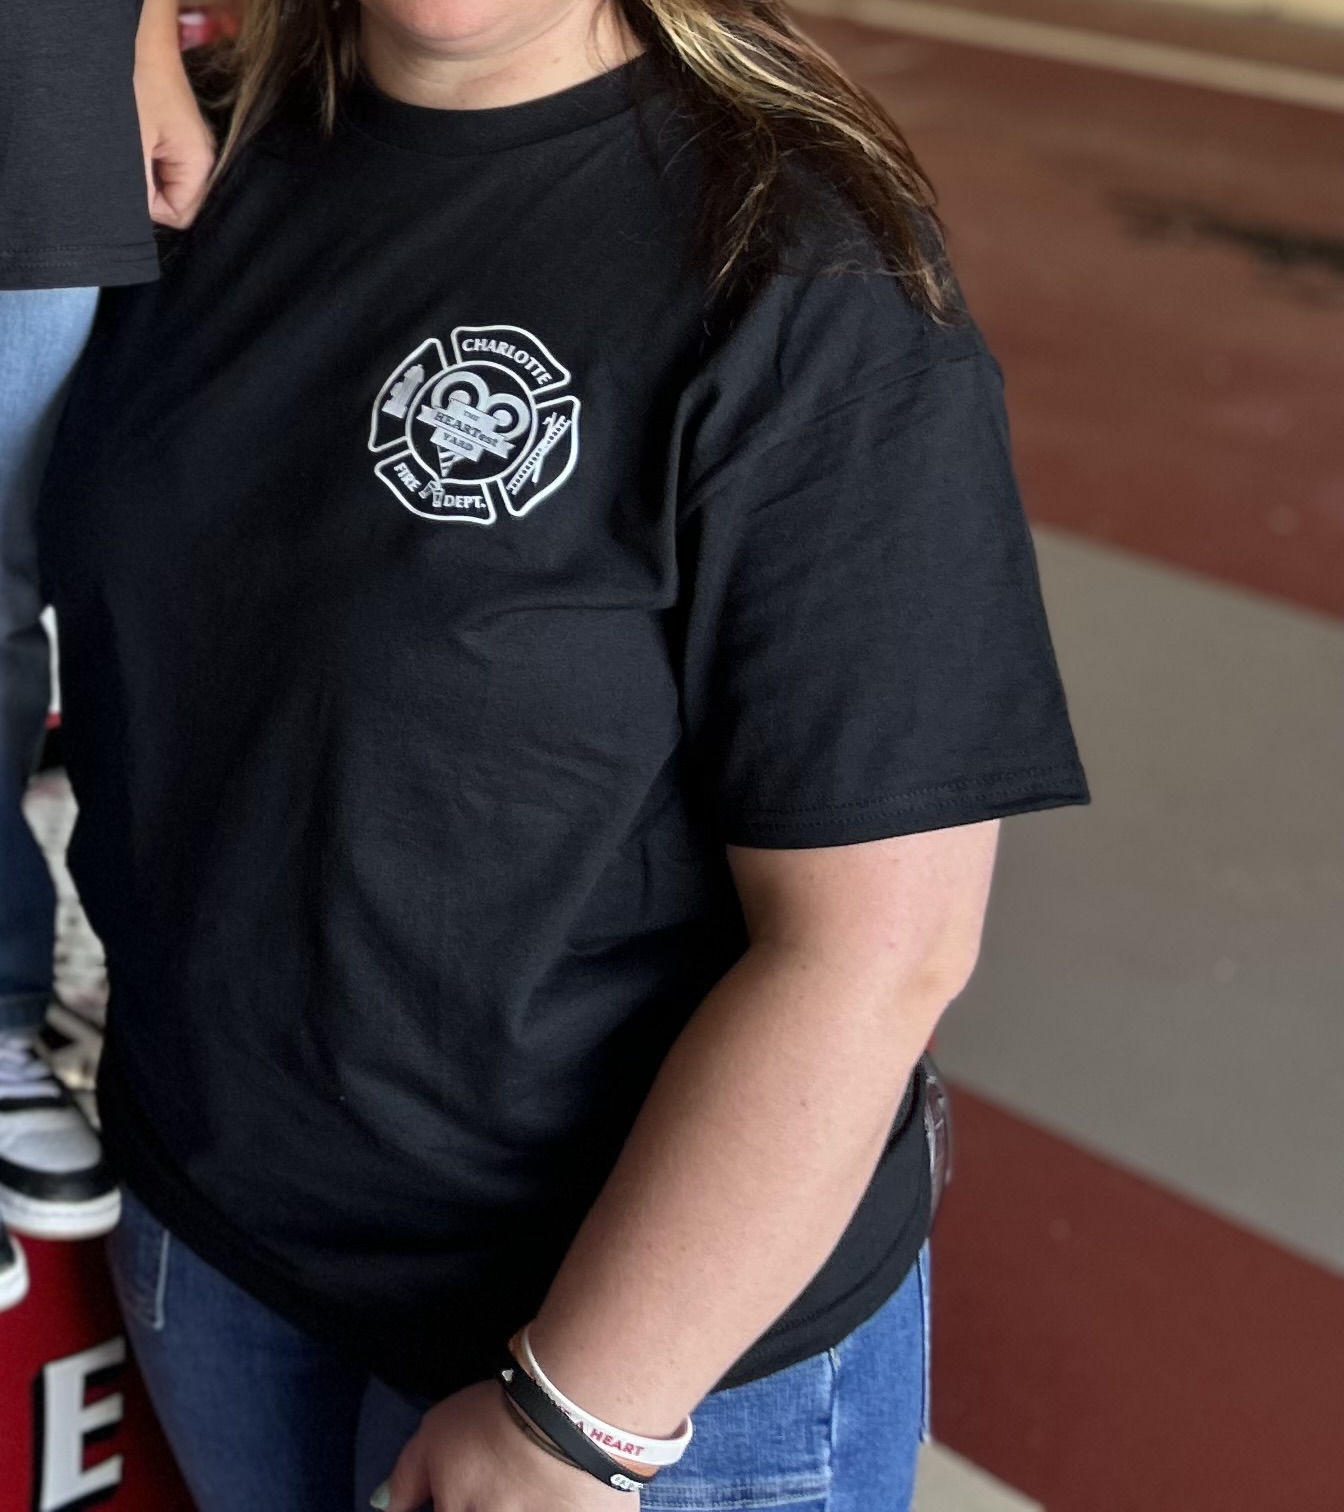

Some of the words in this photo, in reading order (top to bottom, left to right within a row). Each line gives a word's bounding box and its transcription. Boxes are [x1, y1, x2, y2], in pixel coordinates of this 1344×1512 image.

[461, 338, 553, 385] CHARLOTTE
[393, 462, 422, 492] FIRE
[443, 494, 487, 508] DEPT.
[589, 1428, 645, 1456] HEART
